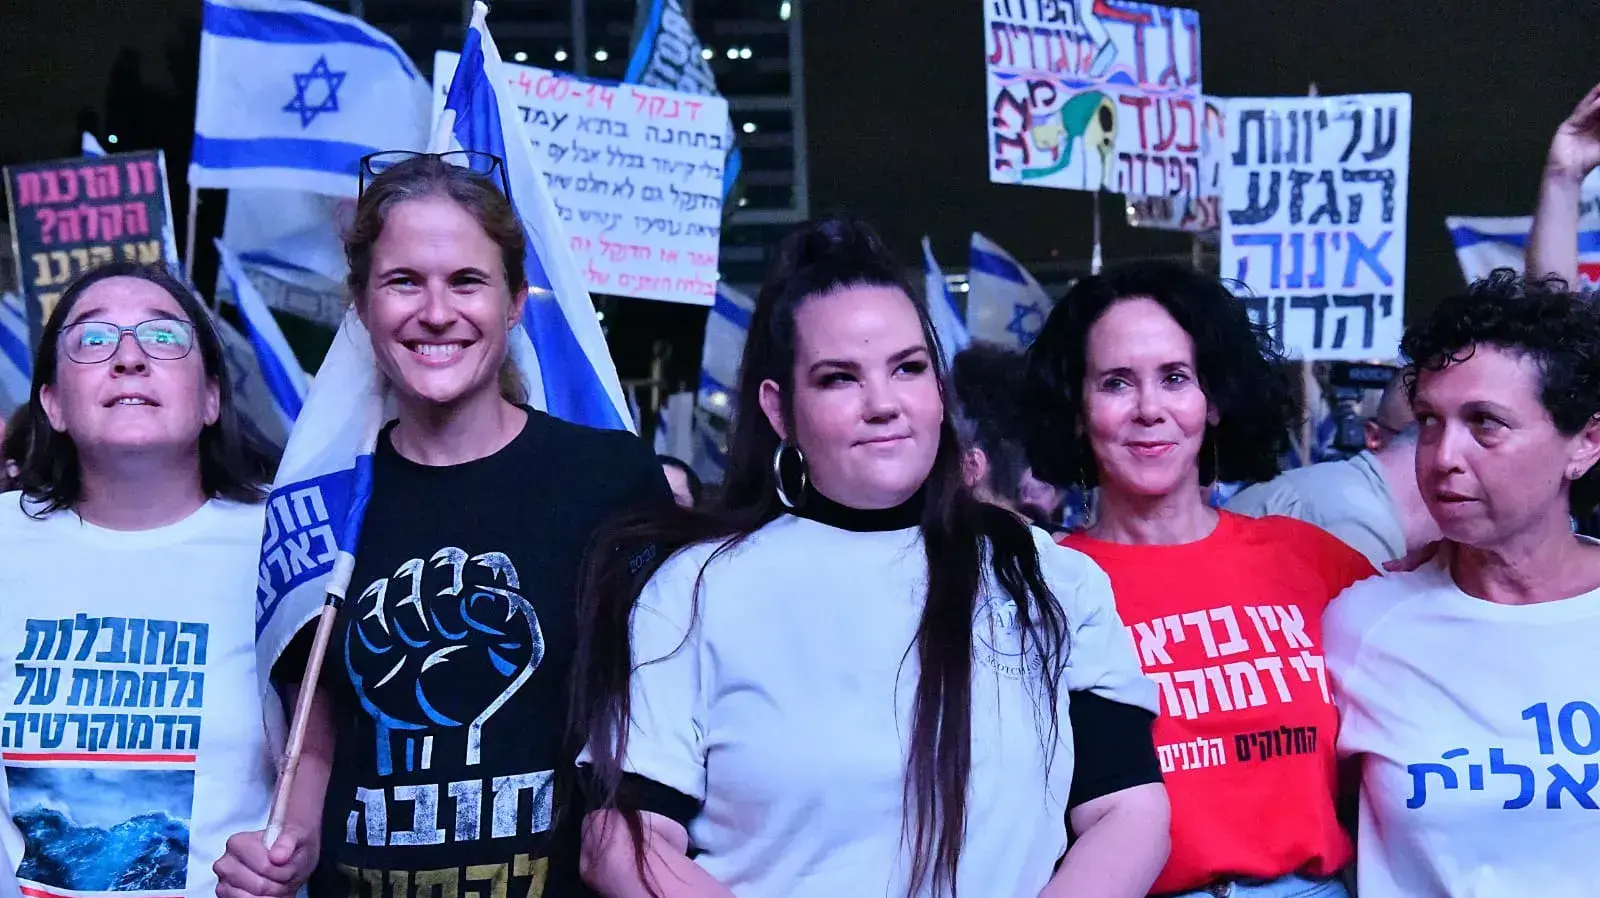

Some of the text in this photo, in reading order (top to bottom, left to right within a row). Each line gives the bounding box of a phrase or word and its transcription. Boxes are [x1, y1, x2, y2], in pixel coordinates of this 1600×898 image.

[1093, 0, 1198, 87] נגד
[517, 104, 568, 133] עמד
[646, 124, 722, 151] בתחנה
[1119, 95, 1199, 153] בעד
[1231, 107, 1397, 166] עליונות
[17, 163, 121, 207] הרכבת
[612, 175, 636, 200] לא
[641, 184, 664, 202] גם
[1118, 152, 1200, 197] הפרדה
[1228, 168, 1395, 225] הגזע
[36, 201, 149, 245] הקלה?
[1232, 231, 1394, 289] איננה
[16, 613, 209, 665] החובלות
[1244, 605, 1314, 653] אין
[14, 663, 205, 708] נלחמות על
[1, 712, 202, 752] הדמוקרטיה
[1157, 725, 1317, 773] החלוקים הלבנים
[346, 769, 555, 847] חובה
